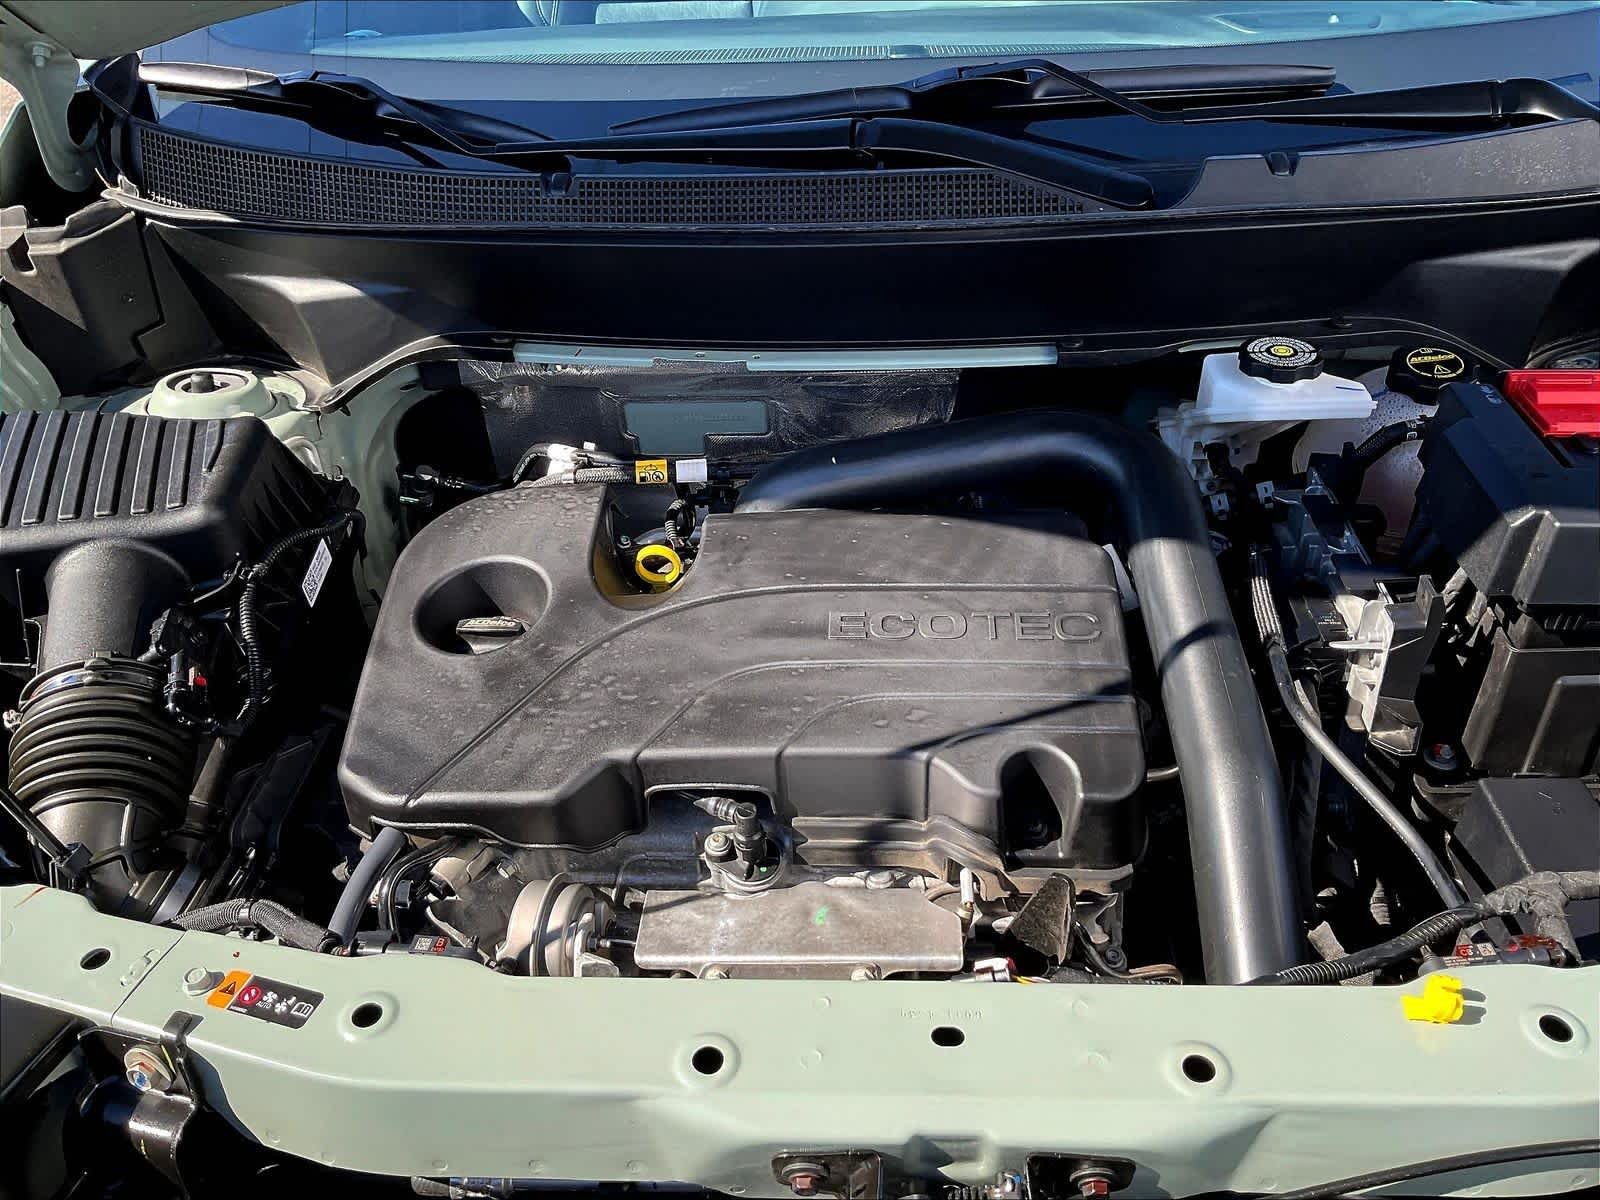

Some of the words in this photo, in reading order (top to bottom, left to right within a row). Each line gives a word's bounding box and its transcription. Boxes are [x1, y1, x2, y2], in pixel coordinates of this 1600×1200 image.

[1410, 354, 1456, 364] ACDelco
[827, 609, 1102, 642] ECOTEC
[255, 1000, 273, 1009] AUTO
